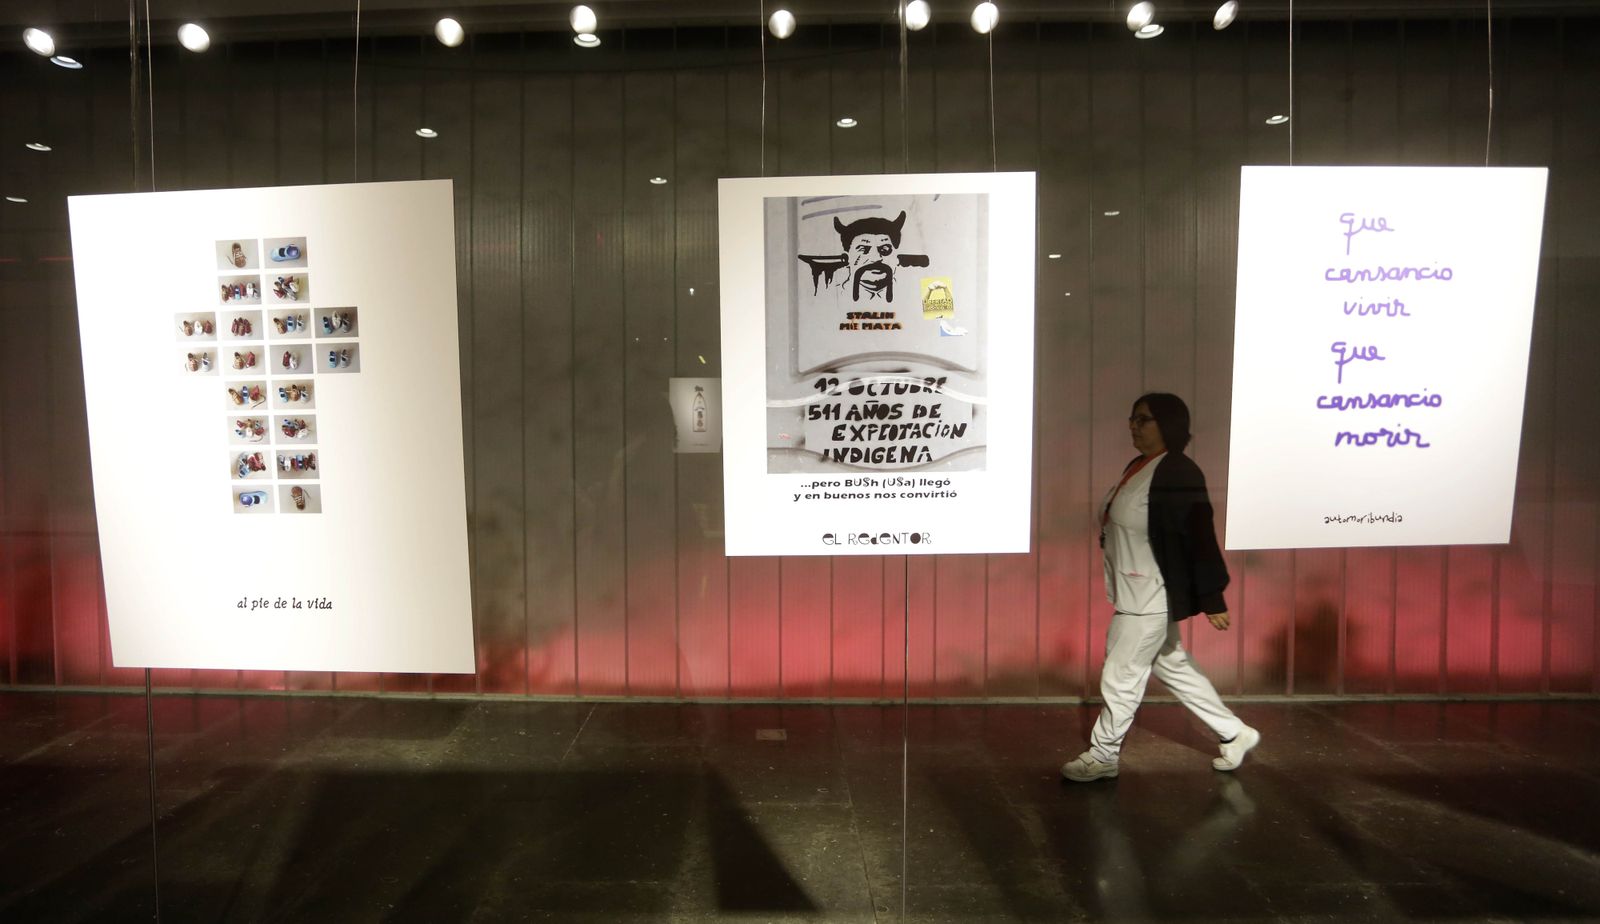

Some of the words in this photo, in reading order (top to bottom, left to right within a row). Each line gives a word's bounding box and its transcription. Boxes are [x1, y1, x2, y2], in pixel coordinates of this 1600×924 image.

[1339, 213, 1394, 256] que
[1325, 262, 1453, 283] cansancio
[846, 311, 895, 319] STALIN
[1344, 297, 1411, 317] vivir
[862, 322, 902, 330] MATA
[1331, 341, 1386, 384] que
[814, 377, 842, 396] 12
[1316, 388, 1442, 411] cansancio
[808, 403, 841, 421] 511
[845, 400, 904, 421] AÑOS
[912, 403, 942, 419] DE
[1335, 424, 1430, 448] morir
[823, 445, 933, 464] INDIGENA
[919, 477, 951, 489] llegó
[793, 493, 802, 503] y
[823, 491, 871, 500] buenos
[899, 489, 958, 499] convirtió
[1324, 512, 1402, 524] automoribundia
[236, 596, 248, 609] al
[250, 597, 270, 612] pie
[273, 596, 288, 609] de
[292, 596, 303, 610] la
[306, 596, 333, 610] vida
